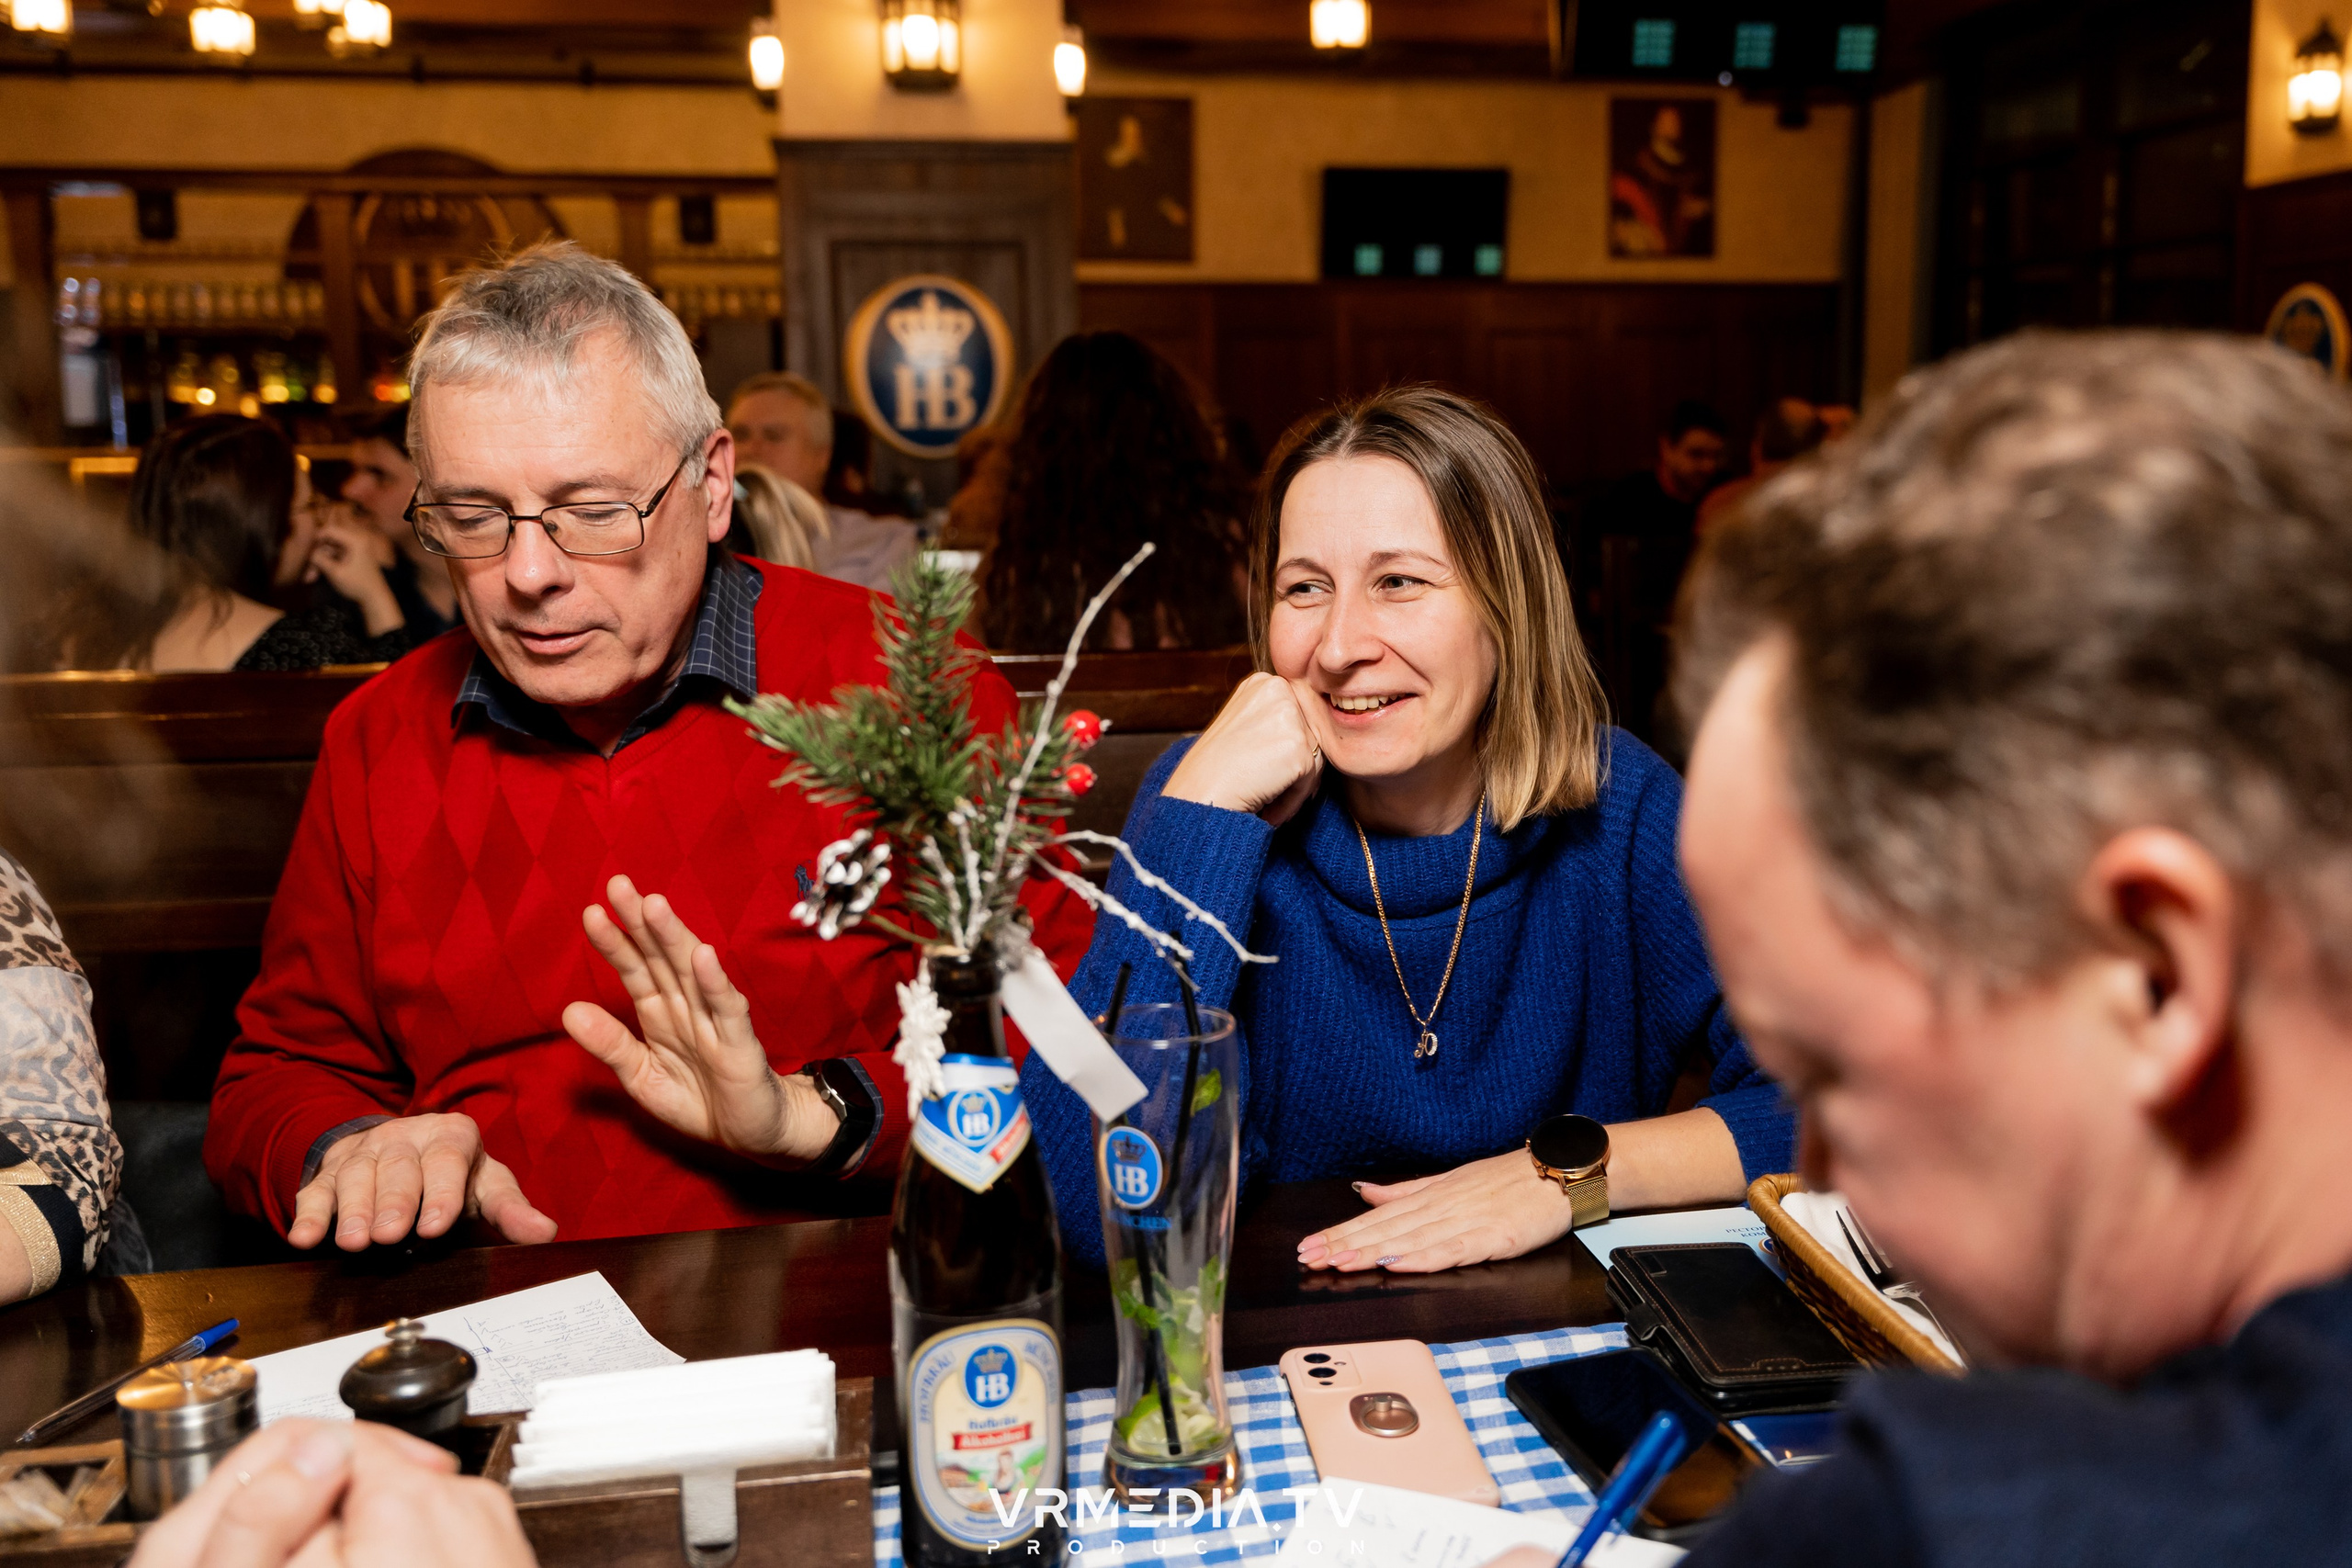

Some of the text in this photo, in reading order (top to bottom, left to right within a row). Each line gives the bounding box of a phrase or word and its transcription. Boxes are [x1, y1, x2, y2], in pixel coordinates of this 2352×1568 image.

[894, 364, 978, 430] HB
[962, 1112, 990, 1137] HB
[1114, 1163, 1149, 1197] HB
[975, 1372, 1011, 1403] HB
